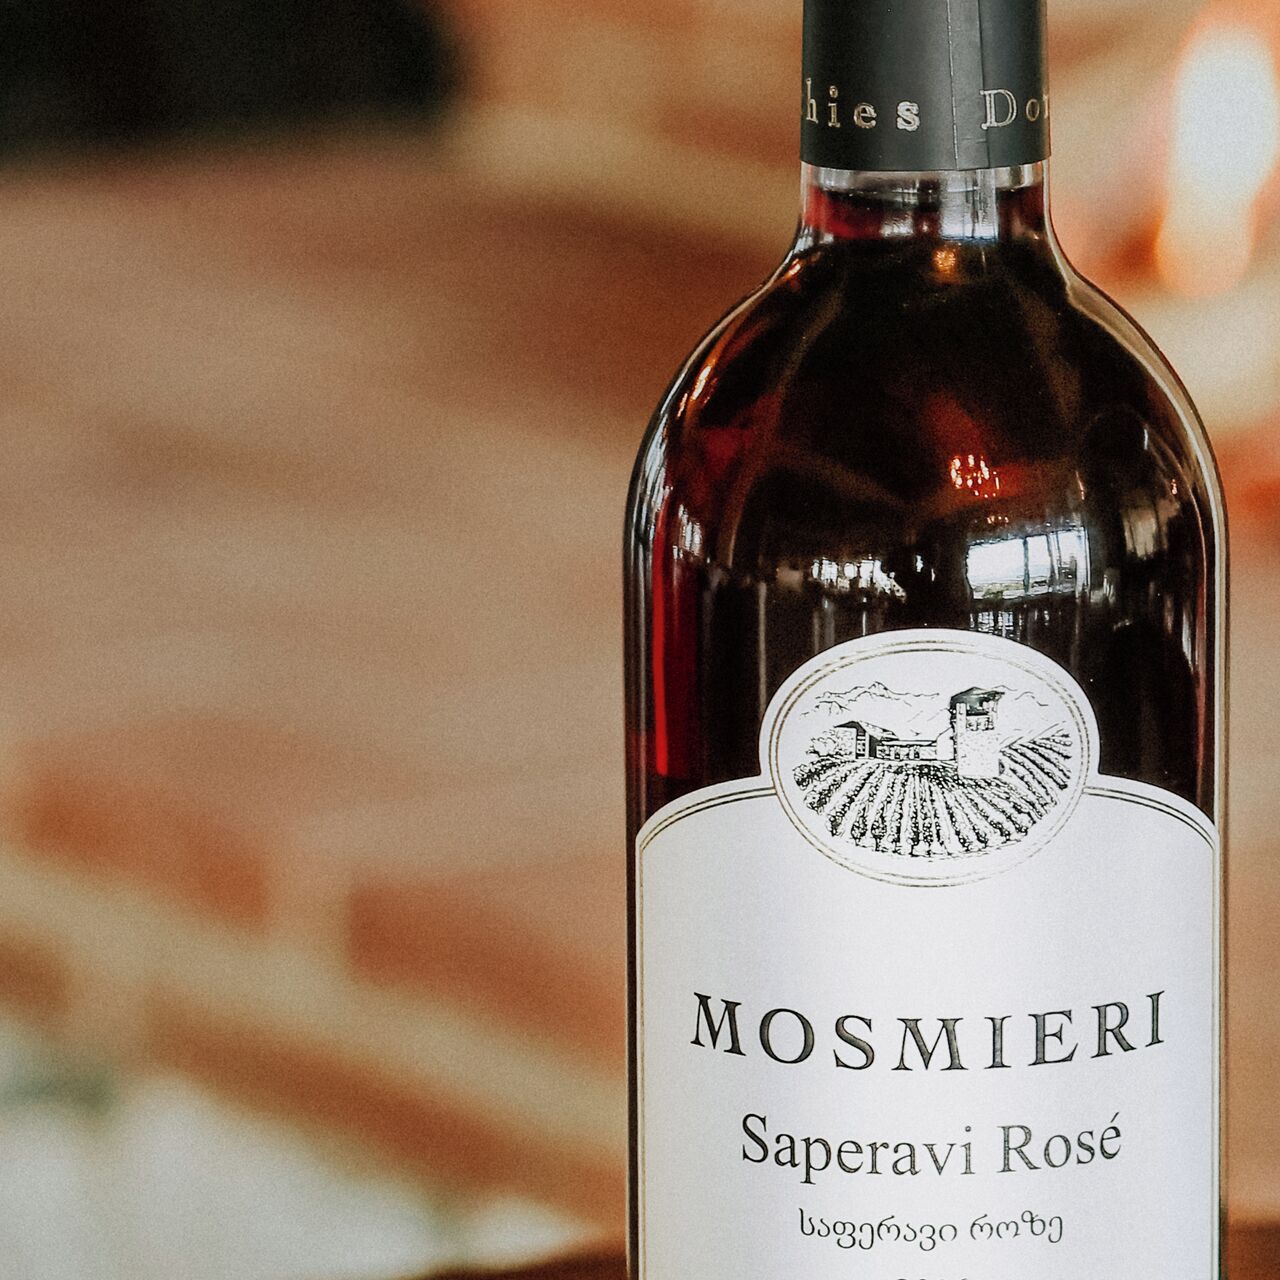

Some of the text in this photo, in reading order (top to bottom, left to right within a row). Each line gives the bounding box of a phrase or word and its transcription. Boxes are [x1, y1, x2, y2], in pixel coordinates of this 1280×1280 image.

[690, 990, 1165, 1071] MOSMIERI
[742, 1112, 1122, 1185] Saperavi Rosé
[799, 1207, 1064, 1251] საფერავი როზე
